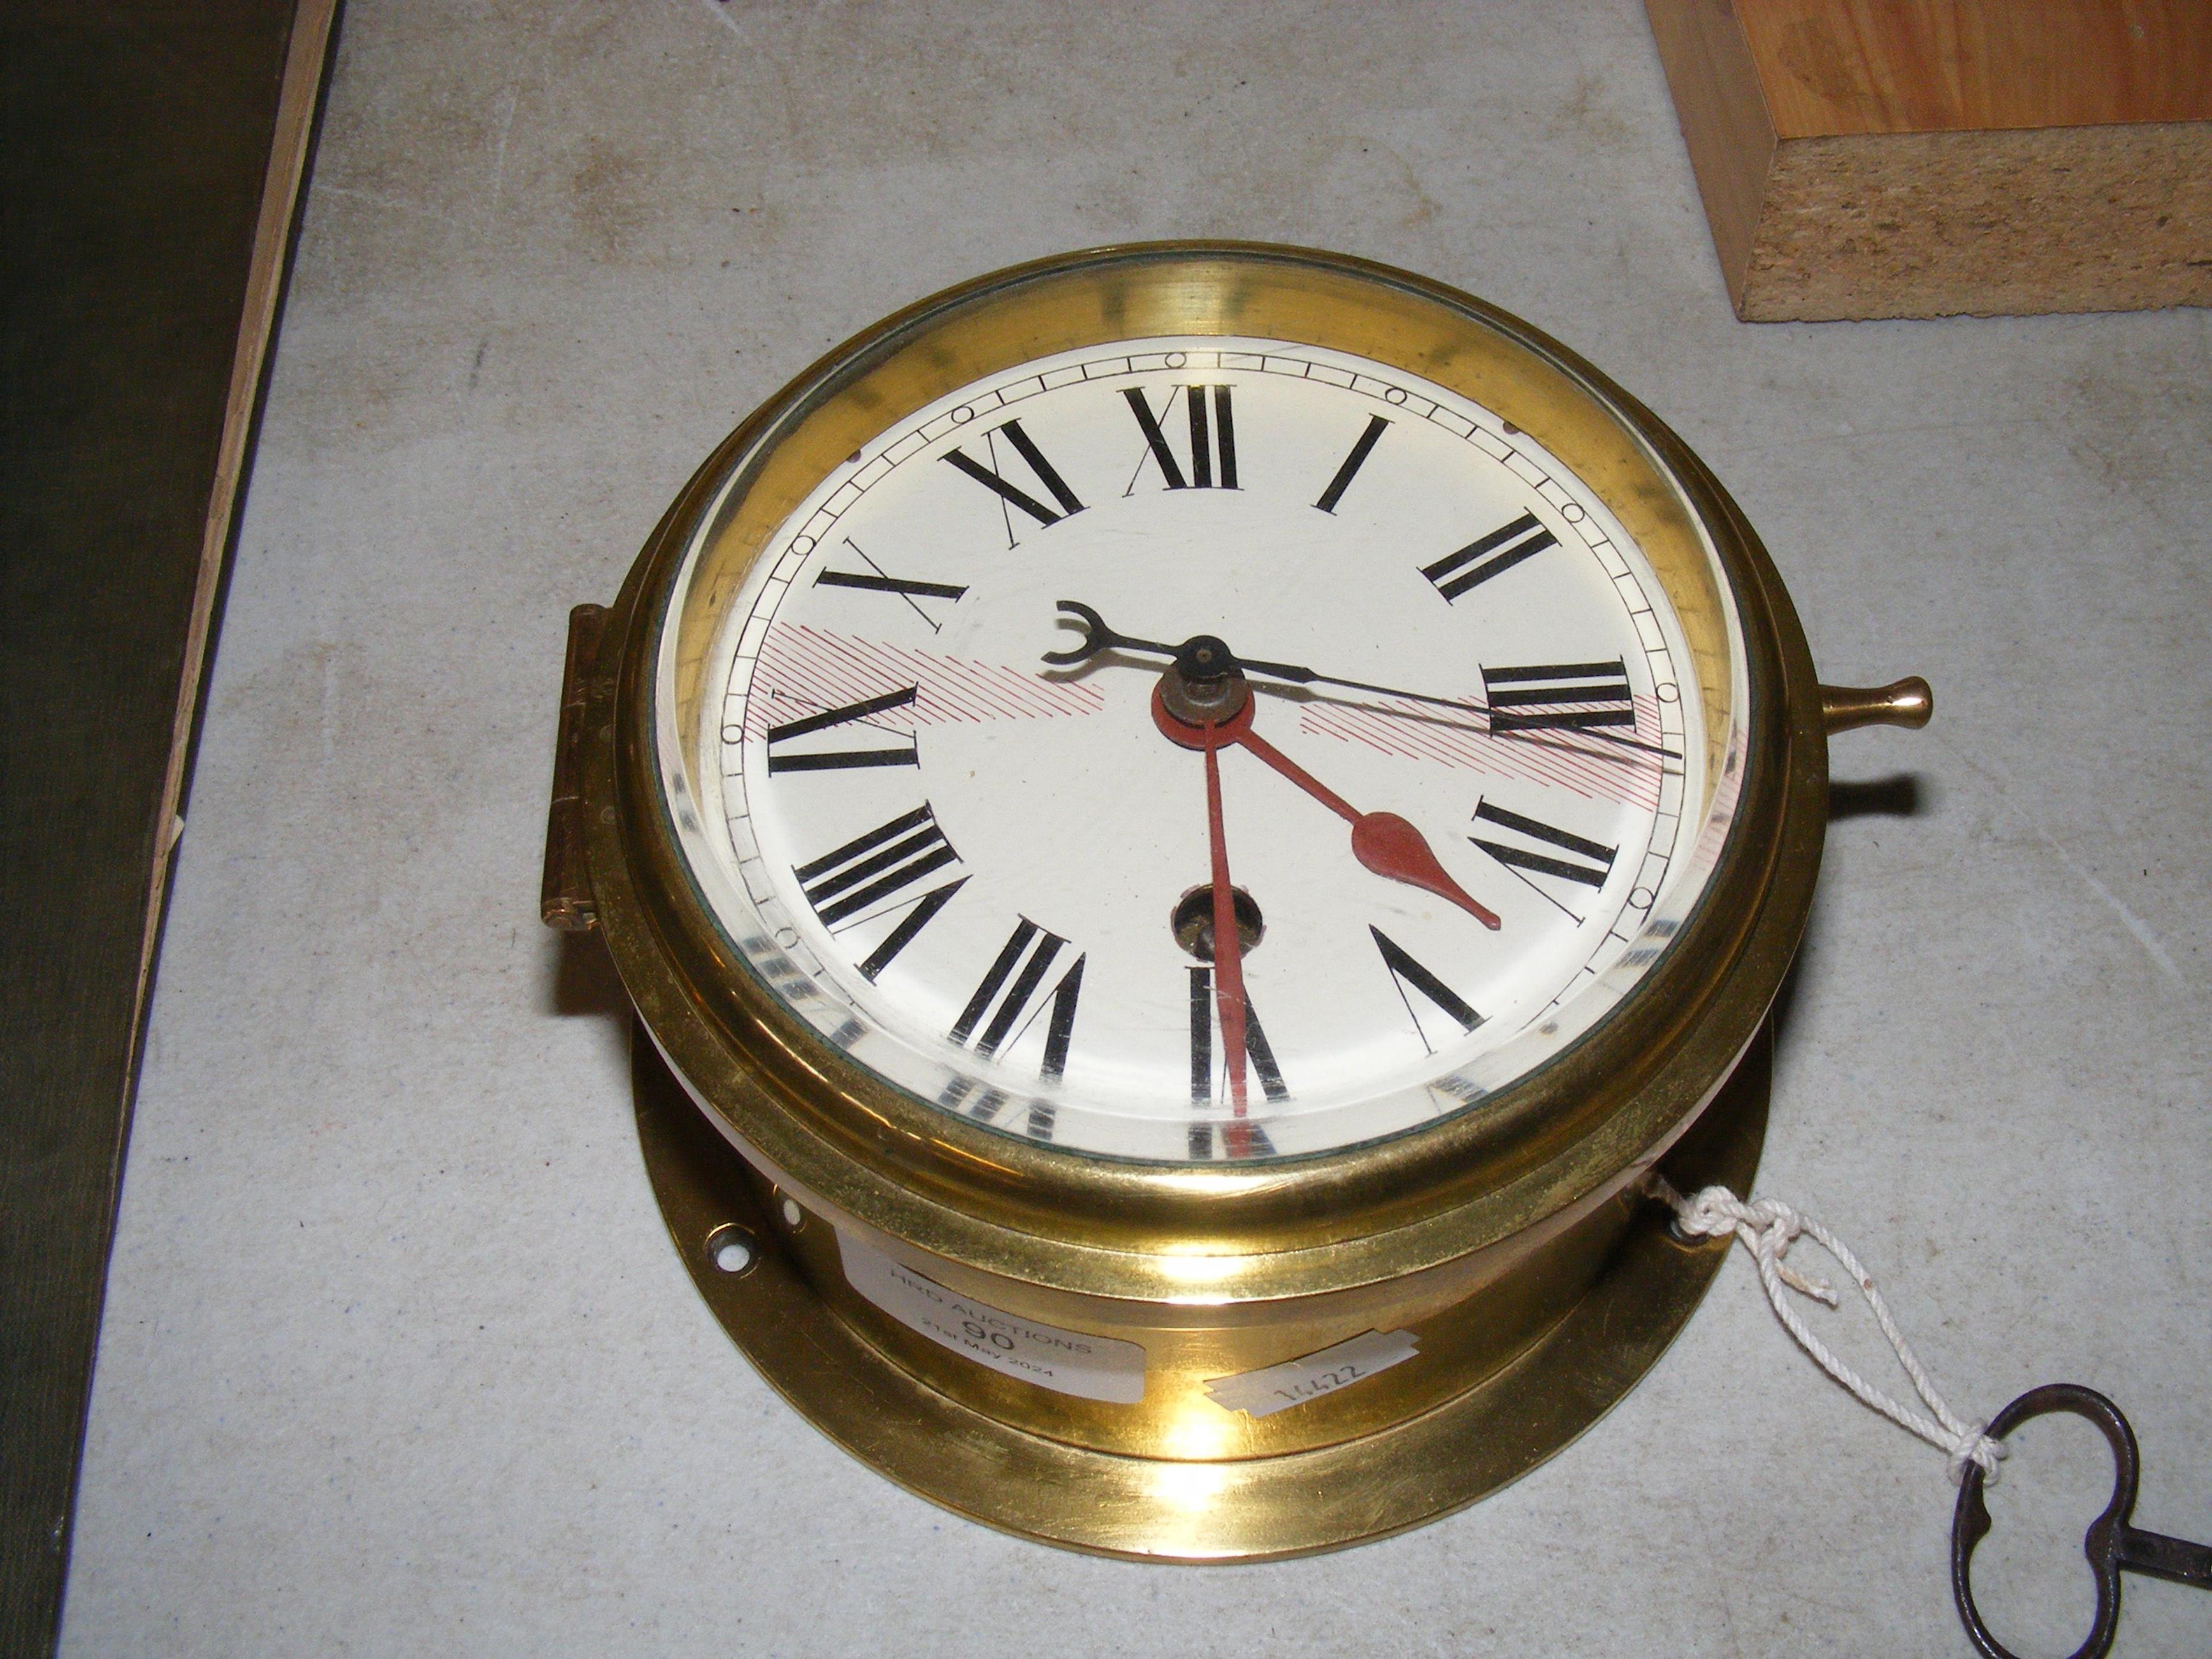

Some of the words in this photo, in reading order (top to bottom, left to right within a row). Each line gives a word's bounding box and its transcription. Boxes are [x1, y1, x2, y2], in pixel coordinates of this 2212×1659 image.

[937, 417, 1091, 551] XI
[1117, 384, 1245, 498] XII
[1310, 412, 1396, 516] I
[811, 536, 970, 635] X
[1415, 506, 1563, 607] II
[767, 681, 921, 778] IX
[1478, 654, 1637, 737] III
[790, 798, 974, 987] VIII
[1466, 794, 1620, 928] IV
[945, 913, 1087, 1086] VII
[1368, 923, 1494, 1059] V
[951, 1303, 1092, 1354] AUCTIONS
[961, 1319, 1015, 1351] 90
[964, 1338, 1001, 1359] May
[1008, 1356, 1055, 1378] 2024
